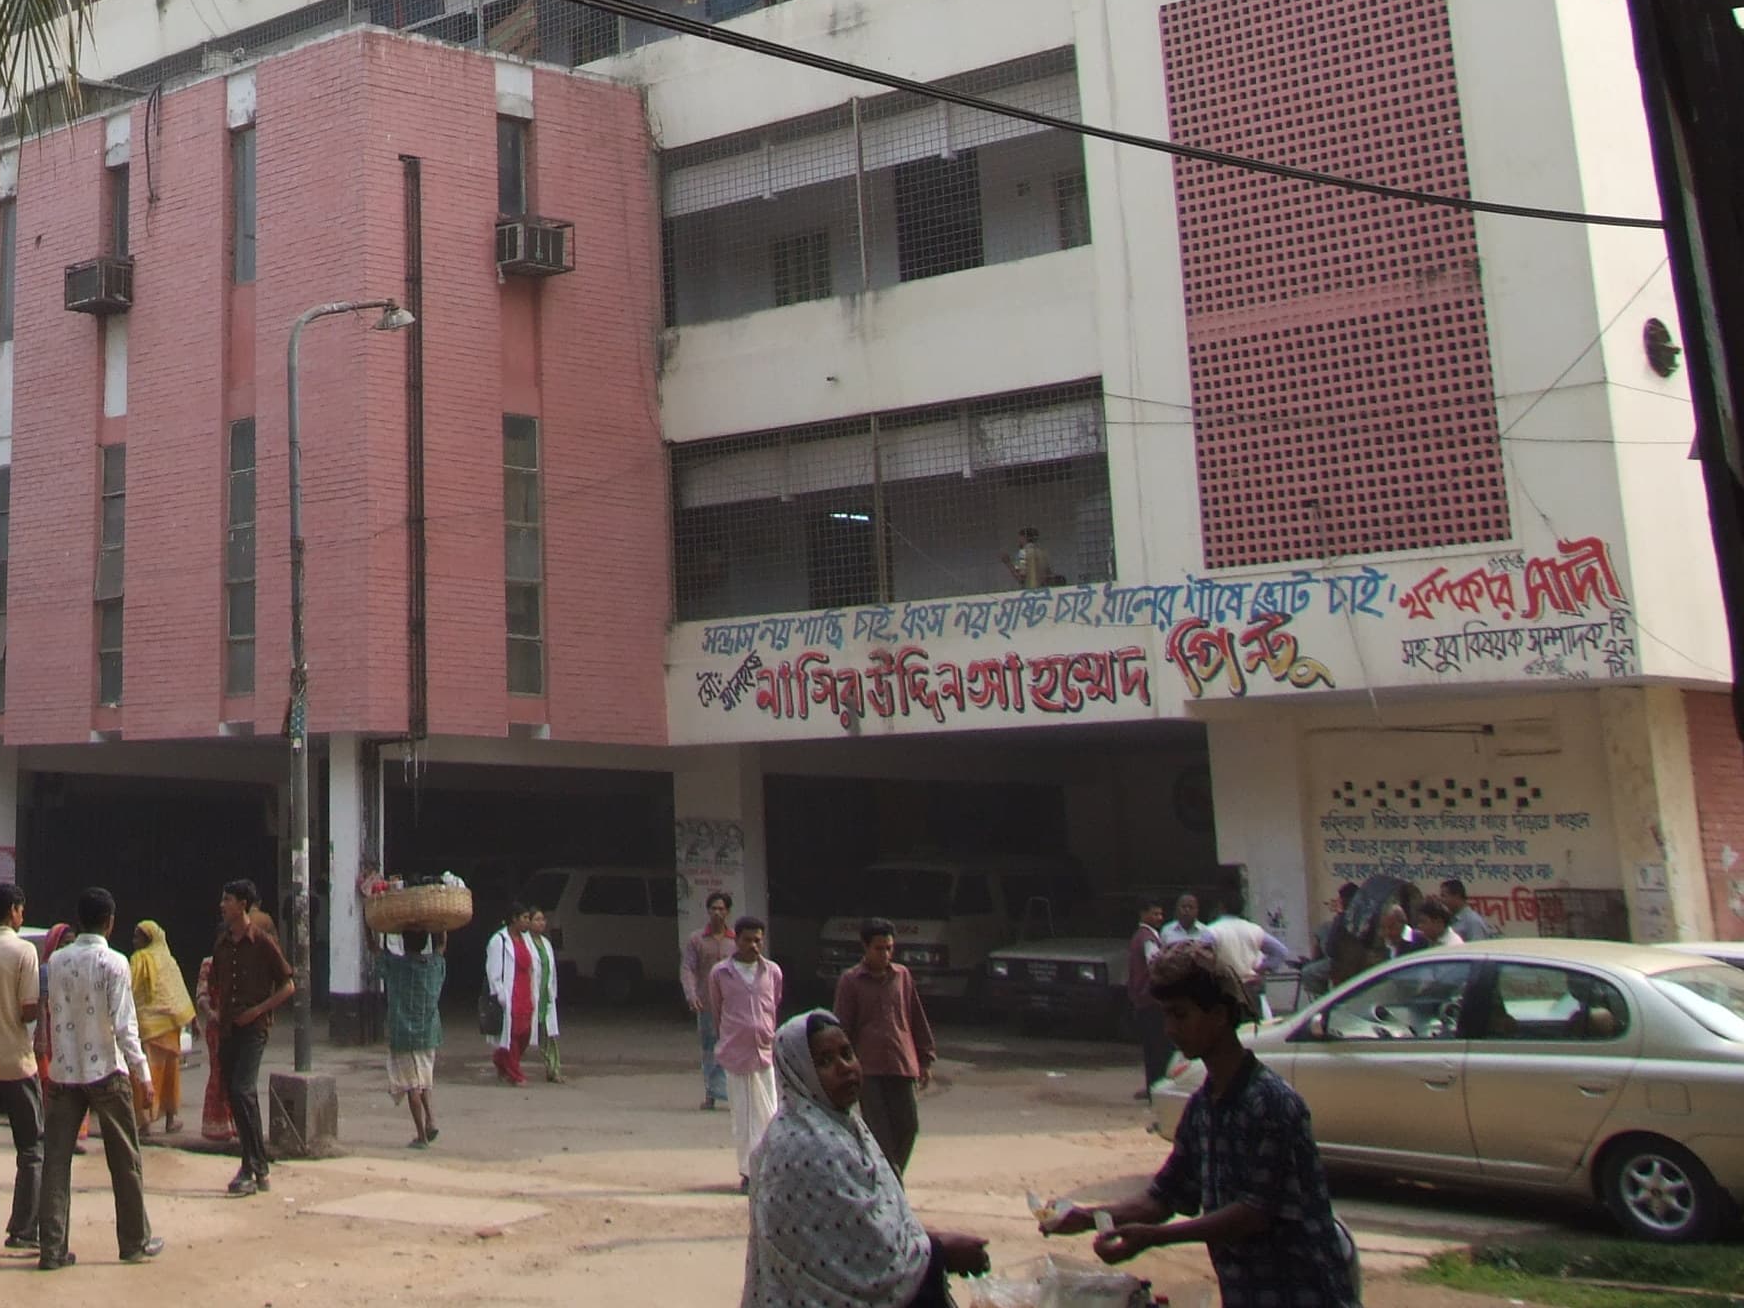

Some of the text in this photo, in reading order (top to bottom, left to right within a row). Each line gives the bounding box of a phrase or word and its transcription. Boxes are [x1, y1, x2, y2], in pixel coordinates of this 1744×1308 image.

[1399, 566, 1516, 621] খন্দকার
[758, 617, 796, 652] নয়
[954, 599, 1000, 640] নয়
[1165, 612, 1337, 698] পিন্টু
